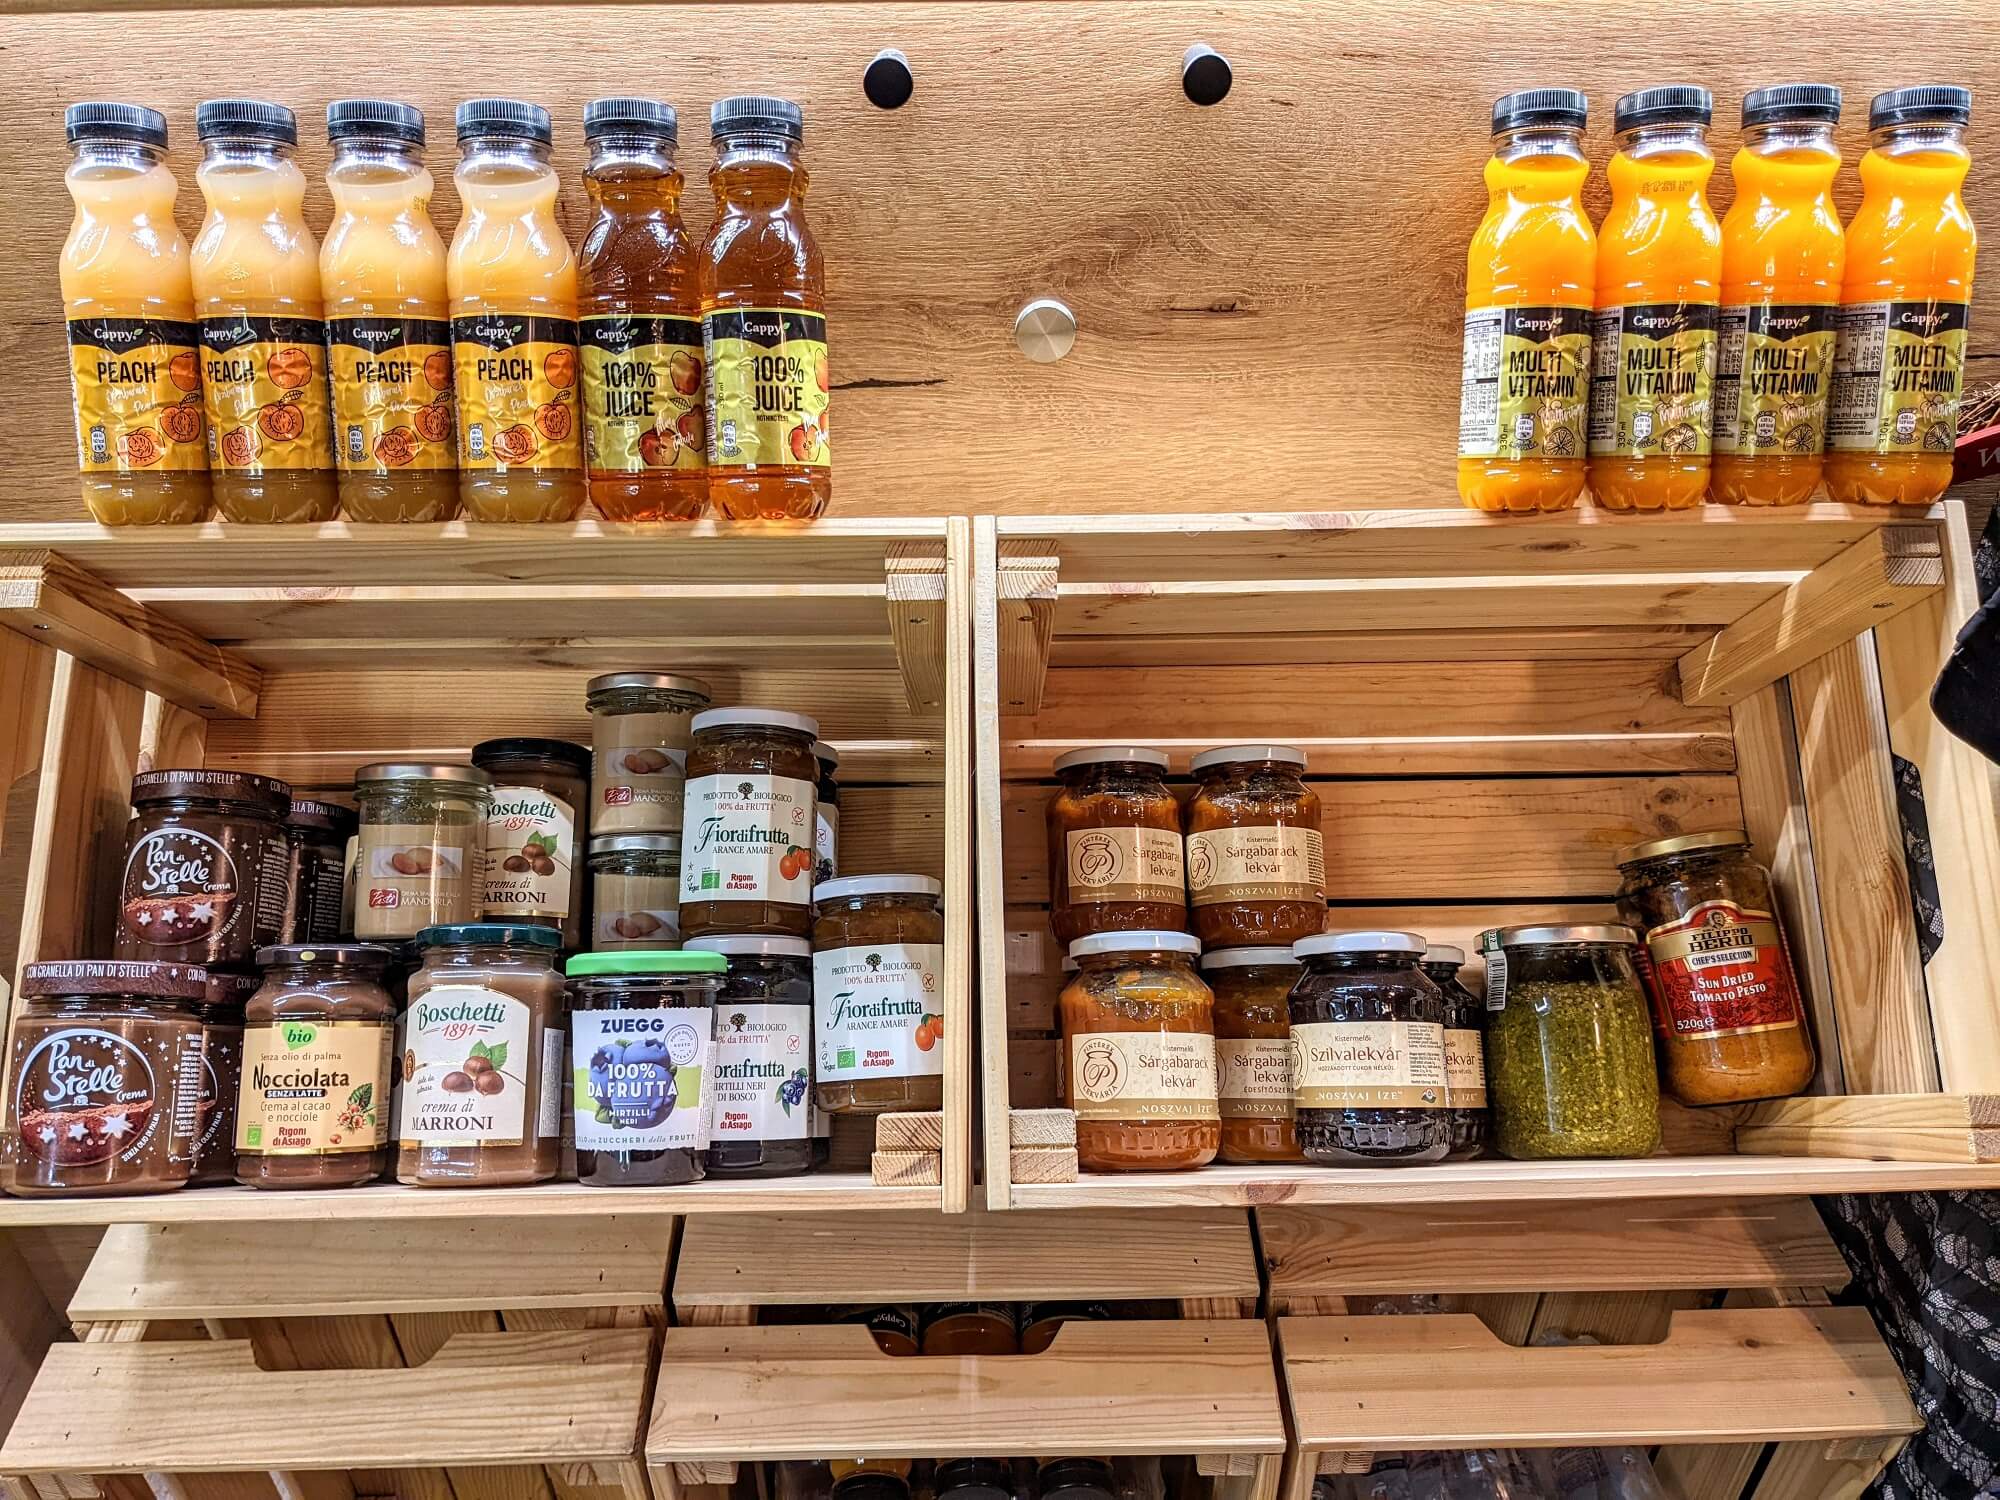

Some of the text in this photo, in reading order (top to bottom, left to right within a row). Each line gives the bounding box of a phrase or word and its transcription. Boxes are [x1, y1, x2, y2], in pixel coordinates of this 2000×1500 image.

[1515, 317, 1553, 331] Cappy
[1632, 315, 1673, 328] Cappy
[1760, 315, 1800, 329] Cappy
[1901, 312, 1941, 327] Cappy
[203, 327, 234, 344] Cappy
[353, 327, 391, 343] Cappy
[475, 325, 514, 342] Cappy
[595, 328, 630, 342] Cappy
[744, 321, 782, 335] Cappy
[94, 328, 133, 345] Cappy
[1509, 350, 1562, 373] MULTI
[1627, 348, 1681, 371] MULTI
[1752, 348, 1808, 371] MULTI
[1893, 345, 1946, 367] MULTI
[97, 361, 158, 383] PEACH
[207, 360, 254, 383] PEACH
[356, 361, 413, 383] PEACH
[477, 358, 533, 381] PEACH
[602, 362, 656, 389] 100%
[753, 355, 804, 383] 100%
[1508, 375, 1575, 398] VITAMIN
[1626, 372, 1697, 395] VITAMIN
[1750, 373, 1819, 395] VITAMIN
[1893, 370, 1955, 393] VITAMIN
[604, 390, 656, 417] JUICE
[752, 387, 804, 412] JUICE
[1500, 423, 1509, 451] 330 ml
[1618, 421, 1627, 448] 330 ml
[1739, 420, 1749, 447] 330 ml
[1879, 416, 1889, 443] 330 ml
[141, 771, 235, 786] GRANELLA DI PAN DI STELLE
[703, 791, 792, 803] PRODOTTO BIOLOGICO
[307, 803, 328, 815] DI PAN
[714, 802, 733, 811] 100%
[734, 802, 744, 811] da
[502, 816, 533, 831] 1891
[694, 815, 790, 854] Fiordifrutta
[146, 837, 181, 867] Pan
[712, 845, 774, 855] ARANCE AMARE
[1226, 845, 1299, 860] Sárgabarack
[142, 859, 209, 891] Stelle
[1150, 863, 1177, 878] lekvár
[1245, 862, 1283, 874] lekvár
[485, 876, 532, 890] crema di
[731, 873, 754, 882] Rigoni
[1079, 871, 1116, 885] LEKVÁRJA
[203, 882, 231, 893] Crema
[726, 882, 757, 890] di Asiago
[484, 891, 548, 904] ARRONI
[1690, 927, 1749, 941] FILIPPO
[1687, 934, 1754, 953] BERIO
[1691, 950, 1753, 967] CHEF'S SELECTION
[26, 964, 150, 978] CON GRANELLA DI PAN DI STELLE
[831, 962, 922, 976] PRODOTTO BIOLOGICO
[844, 975, 863, 985] 100%
[863, 975, 874, 984] da
[1697, 971, 1754, 989] SUN DRIED
[1689, 983, 1766, 1003] TOMATO PESTO
[416, 1001, 506, 1031] Boschetti
[826, 990, 923, 1030] Fiordifrutta
[441, 1022, 476, 1041] 1891
[601, 1019, 665, 1034] ZUEGG
[747, 1023, 787, 1032] BIOLOGICO
[846, 1018, 909, 1030] ARANCE AMARE
[1677, 1018, 1705, 1031] 520g
[287, 1028, 312, 1043] bio
[727, 1035, 771, 1044] da FRUTTA
[866, 1049, 890, 1059] Rigoni
[1083, 1041, 1115, 1054] PINTÉREK
[1310, 1045, 1403, 1063] Szilvalekvár
[48, 1039, 96, 1074] Pan di
[281, 1052, 300, 1061] olio
[302, 1051, 311, 1061] di
[314, 1051, 342, 1062] palma
[862, 1058, 894, 1068] di Asiago
[1138, 1054, 1209, 1072] Sárgabarack
[253, 1062, 350, 1090] Nocciolata
[608, 1063, 656, 1080] 100%
[714, 1058, 785, 1079] ordifrutta
[43, 1065, 124, 1102] Stelle
[1160, 1074, 1198, 1088] lekvár
[1253, 1070, 1294, 1083] lekvár
[587, 1080, 678, 1098] DA FRUTTA
[746, 1081, 766, 1090] NERI
[1082, 1084, 1118, 1099] LEKVÁRJA
[116, 1088, 148, 1102] Crema
[266, 1089, 323, 1098] SENZA LATTE
[717, 1093, 757, 1102] DI BOSCO
[260, 1100, 331, 1112] Crema al cacao
[421, 1098, 475, 1113] crema di
[608, 1109, 650, 1117] MIRTILLI
[267, 1112, 318, 1122] e nocciole
[412, 1116, 494, 1131] MARRONI
[724, 1112, 748, 1122] Rigoni
[200, 1111, 224, 1144] OLIO PALMA
[278, 1127, 307, 1137] Rigoni
[720, 1121, 752, 1130] di Asiago
[121, 1113, 161, 1162] SENZA OLIO PALMA
[272, 1137, 312, 1147] di Asiago
[598, 1136, 646, 1144] ZUCCHERI
[648, 1135, 666, 1144] della
